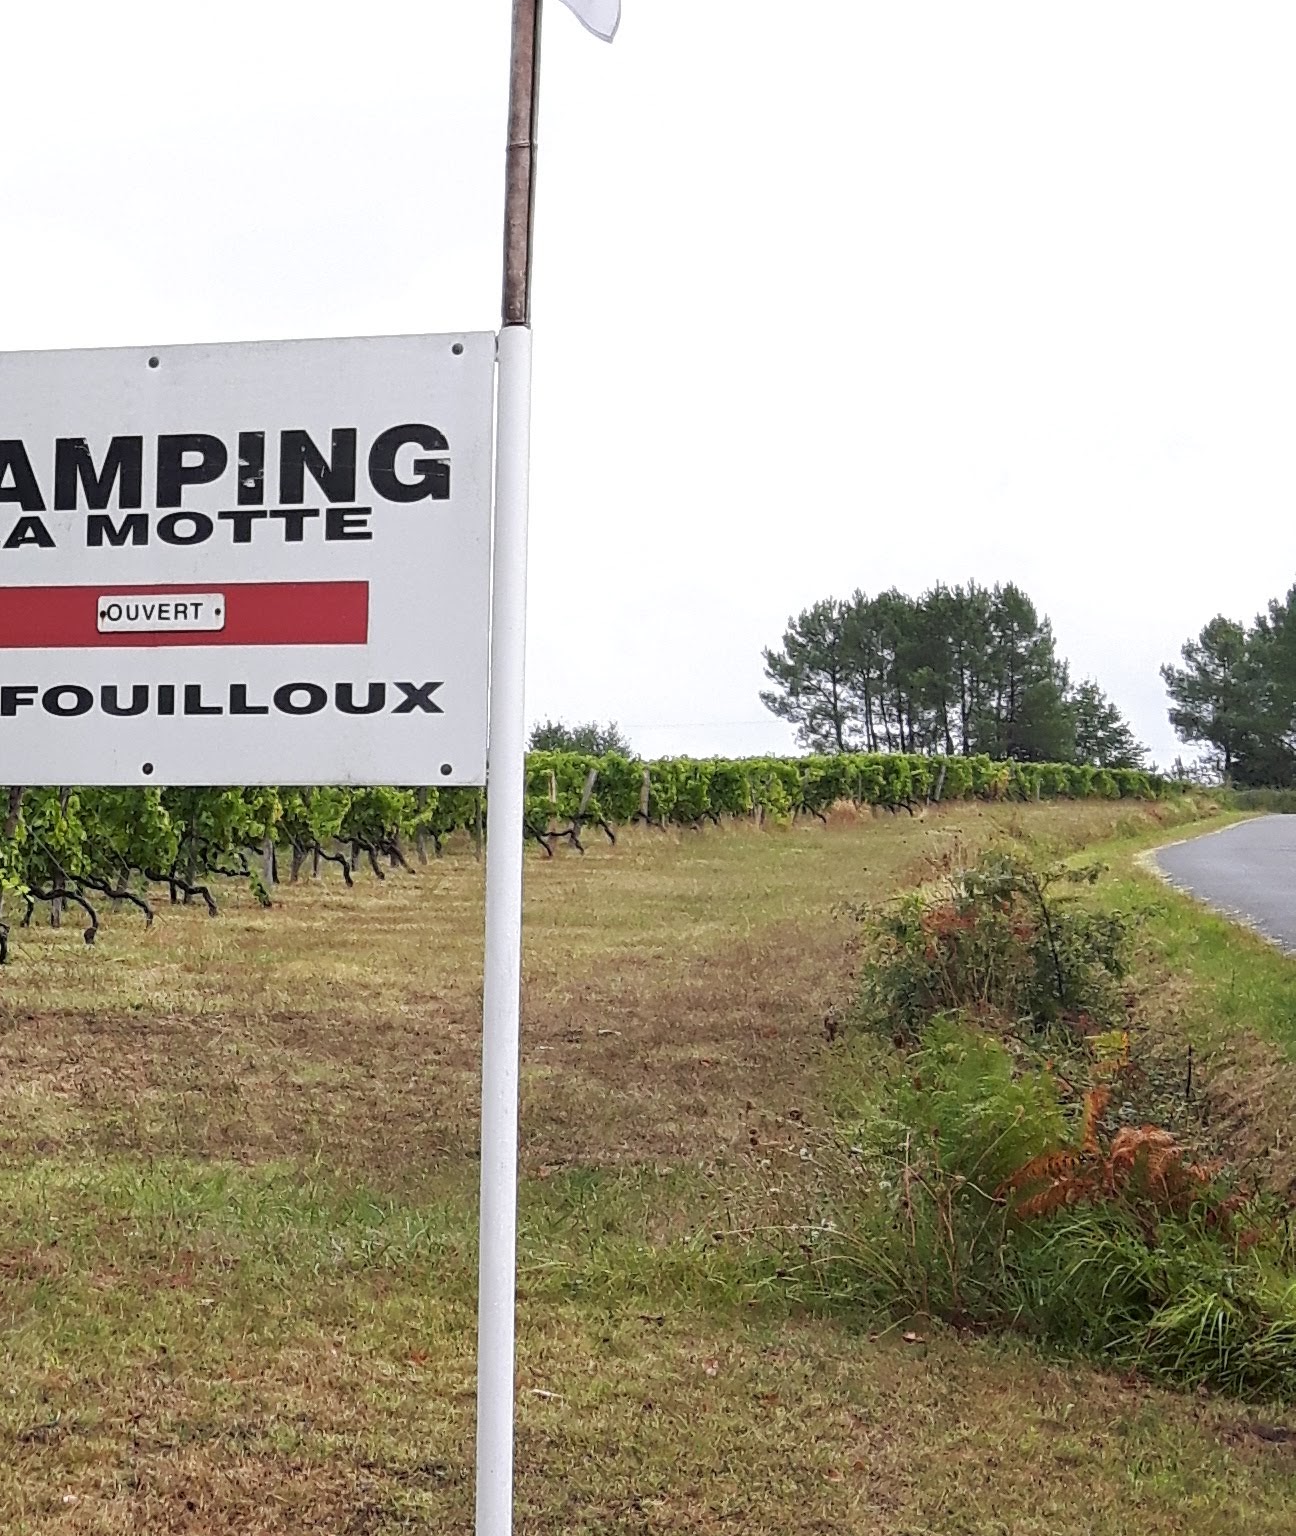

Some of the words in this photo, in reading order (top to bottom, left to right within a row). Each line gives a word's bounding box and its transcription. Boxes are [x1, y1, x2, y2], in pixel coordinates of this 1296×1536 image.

[86, 506, 374, 547] MOTTE
[106, 602, 204, 622] OUVERT
[0, 681, 445, 717] FOUILLOUX
